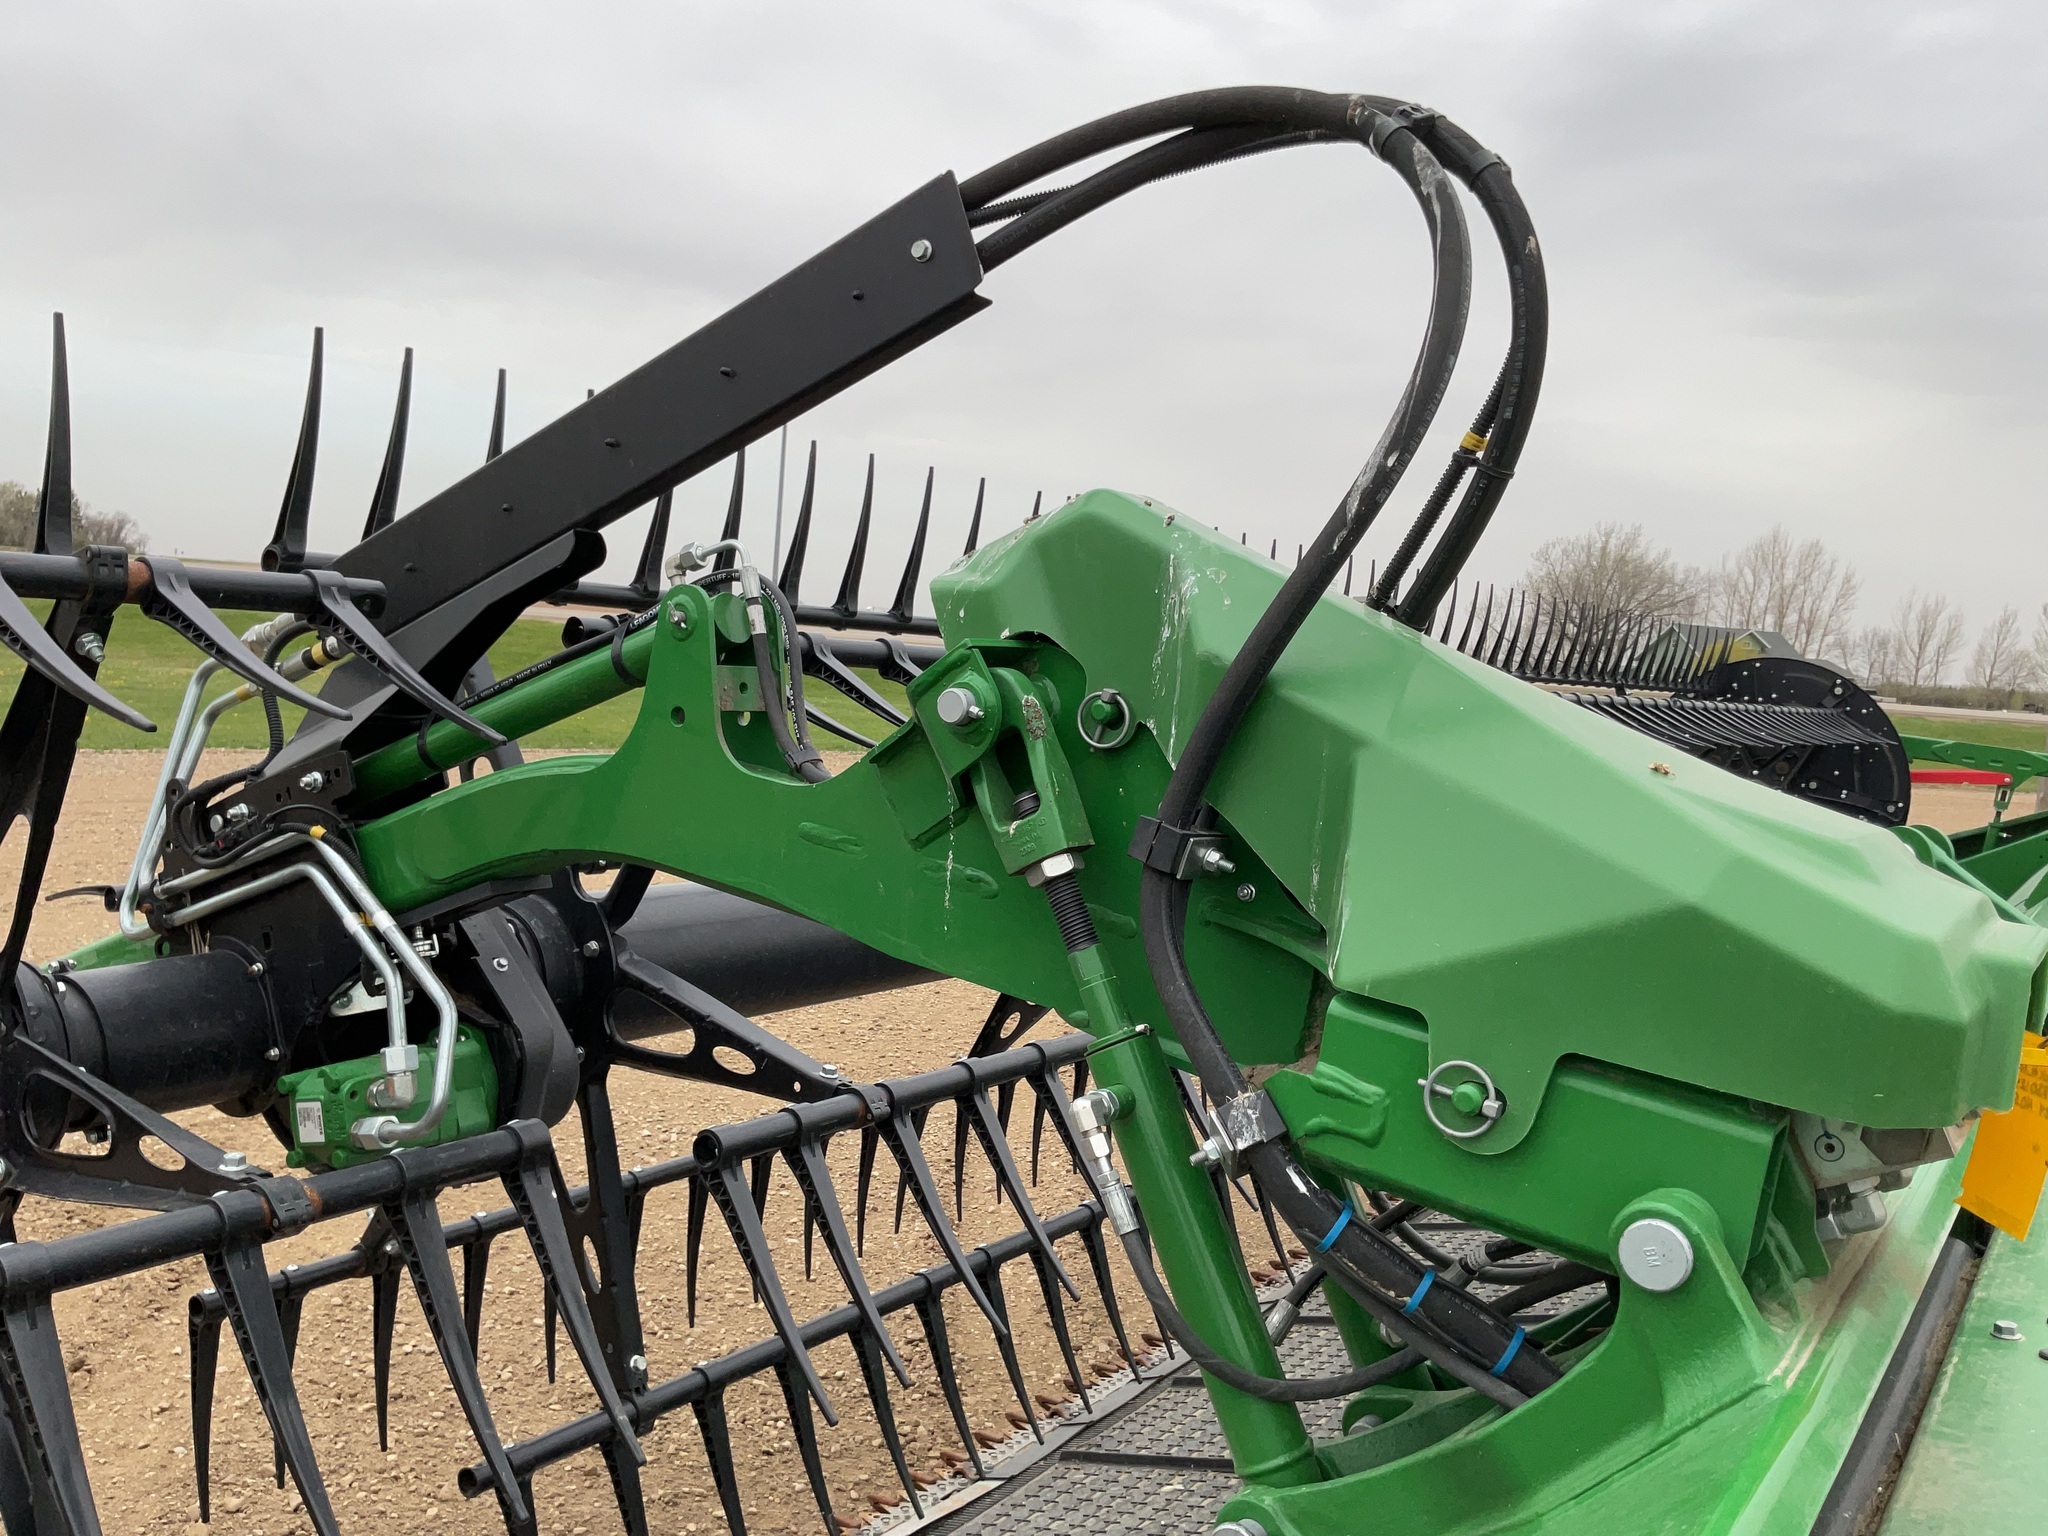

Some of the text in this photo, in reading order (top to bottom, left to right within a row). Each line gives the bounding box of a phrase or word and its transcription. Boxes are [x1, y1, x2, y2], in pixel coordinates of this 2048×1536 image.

[696, 572, 727, 588] PERTUFF
[324, 769, 333, 784] 2
[285, 786, 292, 802] 1
